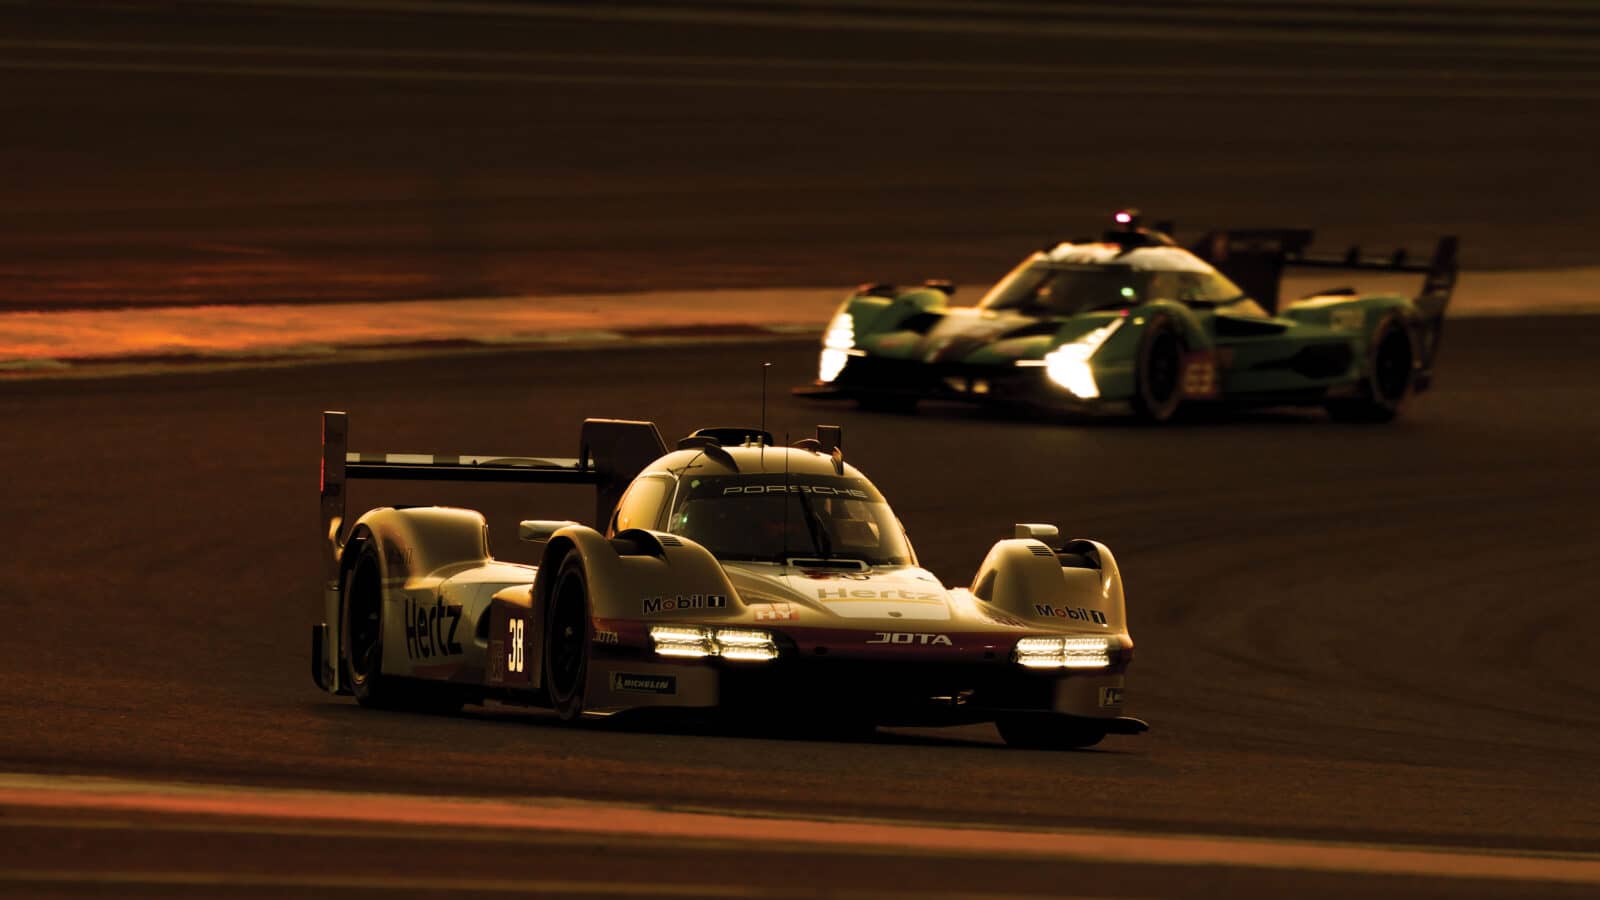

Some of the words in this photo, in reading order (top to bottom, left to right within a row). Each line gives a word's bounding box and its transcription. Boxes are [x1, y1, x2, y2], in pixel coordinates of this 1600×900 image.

[722, 484, 868, 499] PORSCHE
[816, 588, 943, 602] Hertz
[643, 594, 703, 614] Mobil
[708, 595, 725, 608] 1
[1035, 604, 1089, 621] Mobil
[405, 596, 463, 659] Hertz
[507, 618, 525, 672] 38
[864, 632, 953, 646] JOTA
